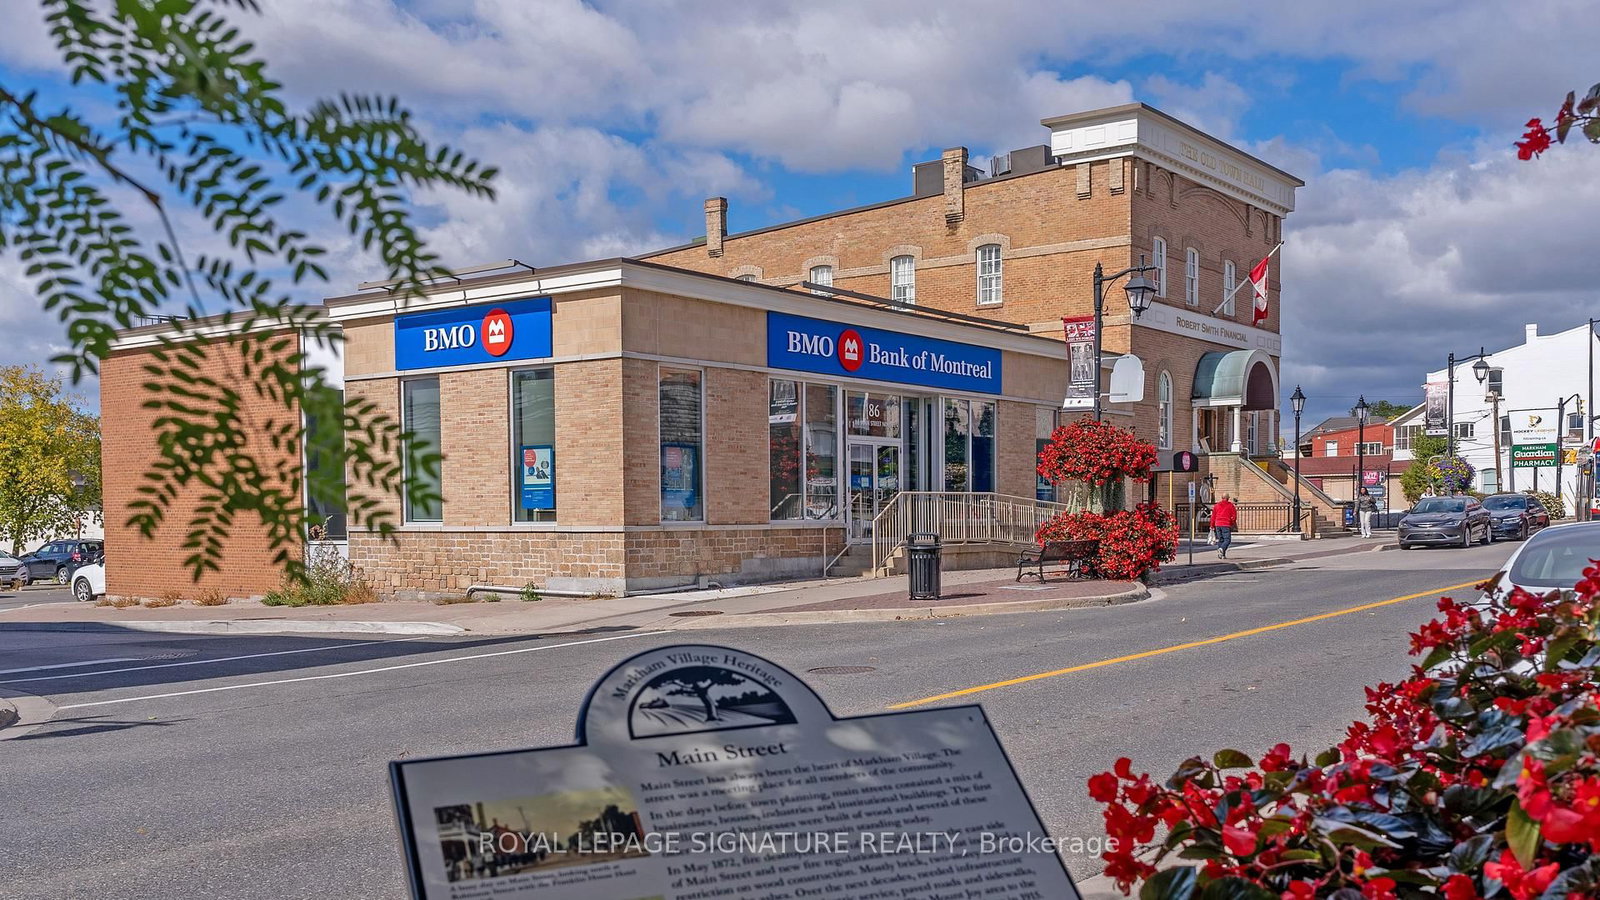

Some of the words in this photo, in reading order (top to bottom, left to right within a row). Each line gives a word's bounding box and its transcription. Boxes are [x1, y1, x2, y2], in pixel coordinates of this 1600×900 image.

[423, 324, 476, 352] BMO
[787, 330, 834, 357] BMO
[869, 343, 910, 368] Bank
[912, 351, 928, 369] of
[930, 352, 993, 379] Montreal
[868, 403, 880, 418] 86
[1514, 450, 1554, 458] Guardian
[1514, 459, 1554, 467] PHARMACY
[612, 660, 666, 701] Markham
[667, 652, 719, 665] Village
[724, 654, 782, 688] Heritage
[655, 747, 719, 768] Main
[723, 741, 788, 760] Street
[640, 783, 670, 791] Main
[853, 756, 901, 765] Markham
[759, 781, 784, 792] place
[788, 778, 801, 786] for
[806, 776, 818, 784] all
[650, 812, 662, 820] In
[666, 810, 682, 818] the
[686, 807, 711, 816] days
[714, 802, 746, 811] before
[780, 793, 830, 806] planning,
[832, 788, 859, 797] main
[861, 785, 892, 793] streets
[895, 777, 942, 789] contained
[817, 802, 836, 811] and
[864, 807, 892, 816] wood
[895, 804, 913, 813] and
[667, 867, 681, 875] In
[684, 864, 708, 872] May
[712, 858, 740, 869] 1872,
[742, 855, 760, 864] fire
[672, 878, 682, 888] of
[686, 876, 717, 886] Main
[719, 871, 751, 881] Street
[755, 866, 776, 876] and
[803, 860, 820, 869] fire
[964, 874, 983, 884] and
[754, 878, 784, 889] wood
[795, 888, 822, 896] Over
[825, 884, 842, 892] the
